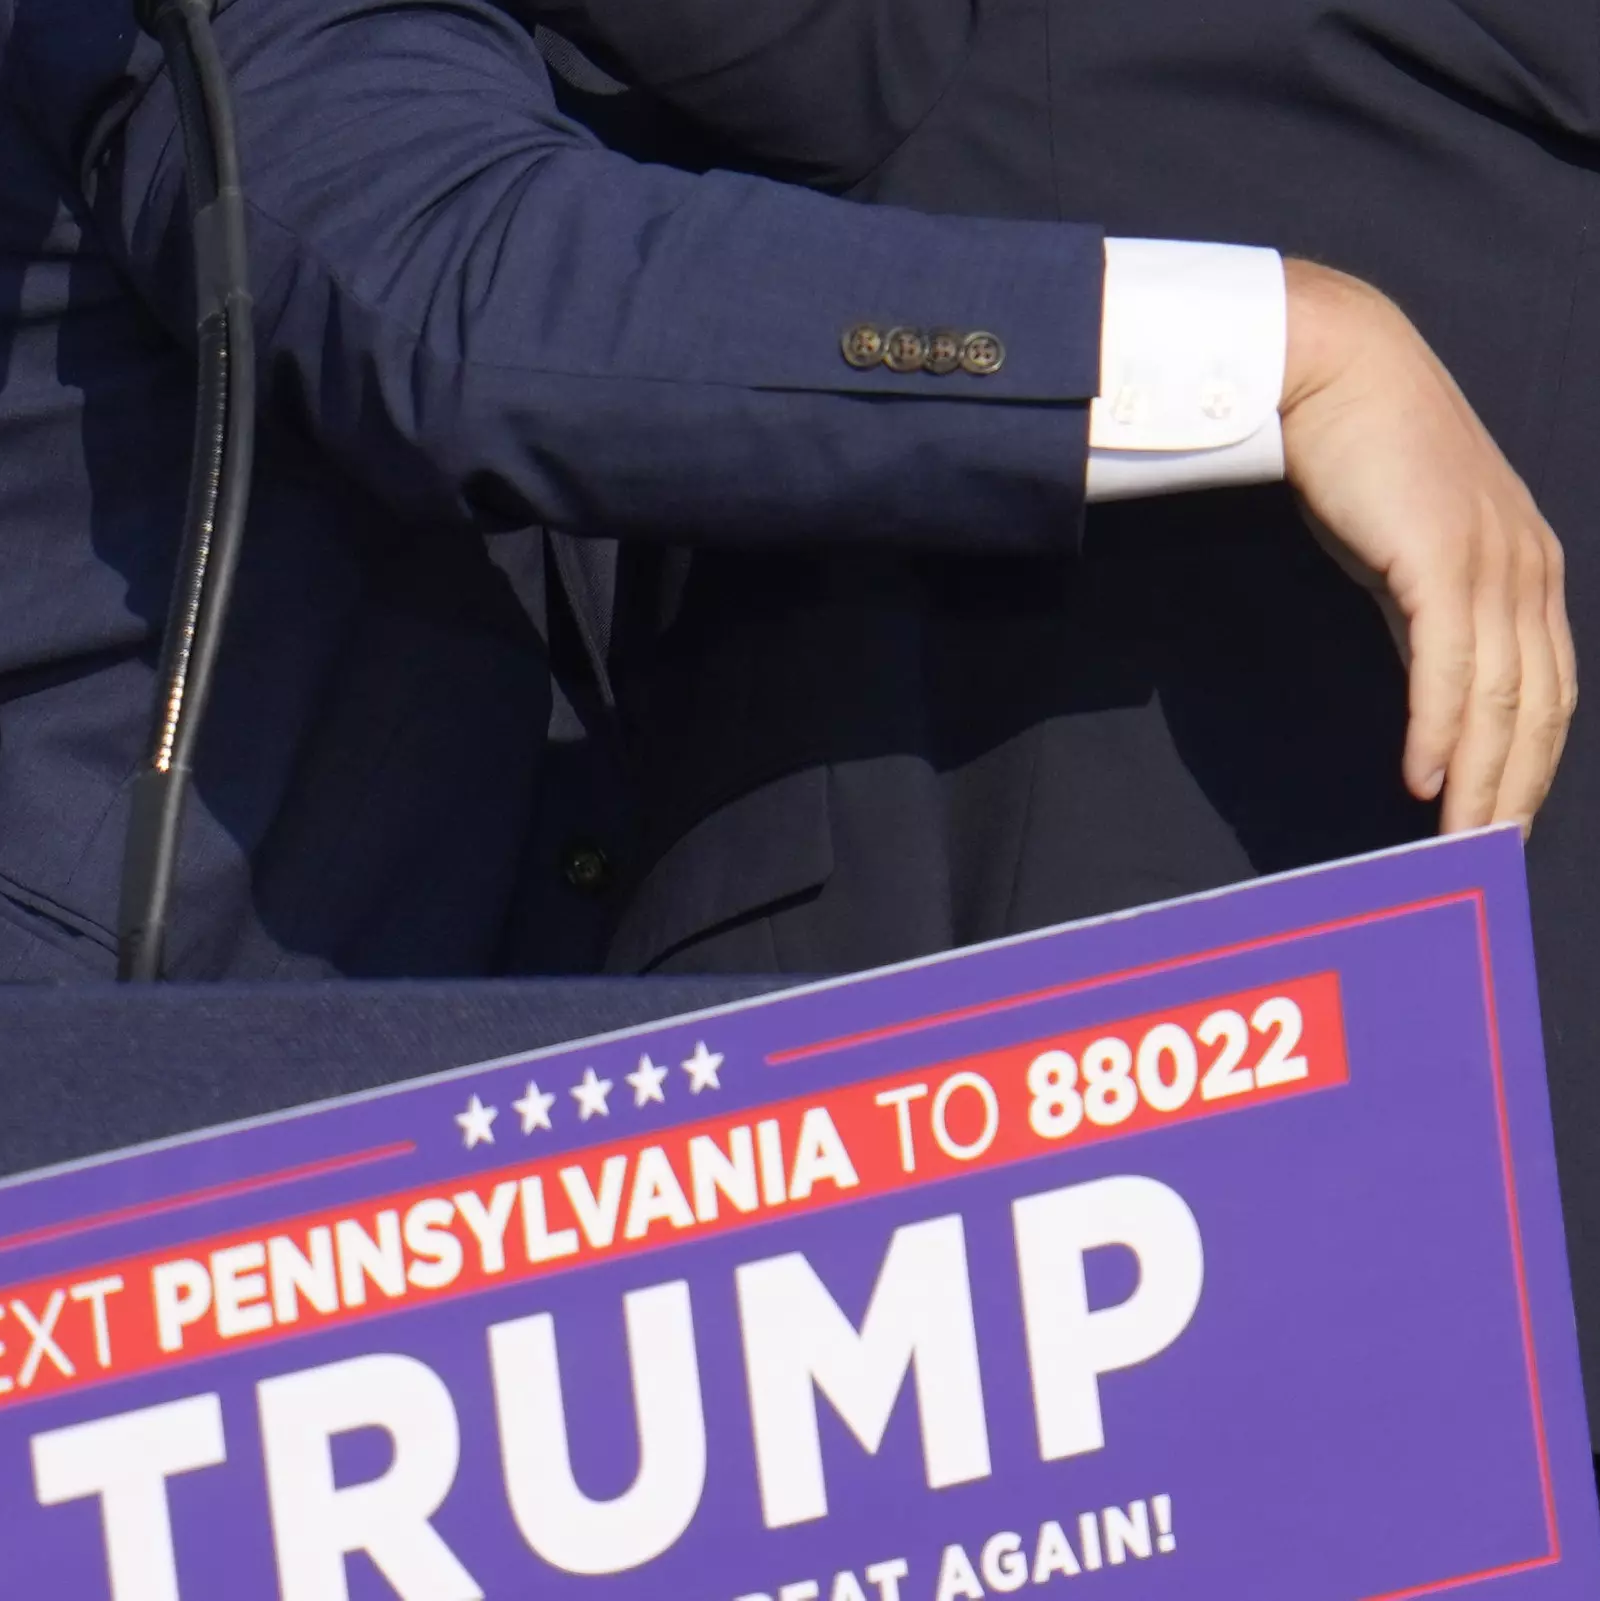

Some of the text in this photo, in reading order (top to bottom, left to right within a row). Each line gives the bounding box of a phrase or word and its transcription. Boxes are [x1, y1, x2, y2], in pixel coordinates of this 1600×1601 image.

[151, 1106, 861, 1354] PENNSYLVANIA
[874, 1070, 1000, 1173] TO
[1025, 994, 1310, 1140] 88022
[30, 1173, 1205, 1601] TRUMP
[935, 1492, 1177, 1601] AGAIN!
